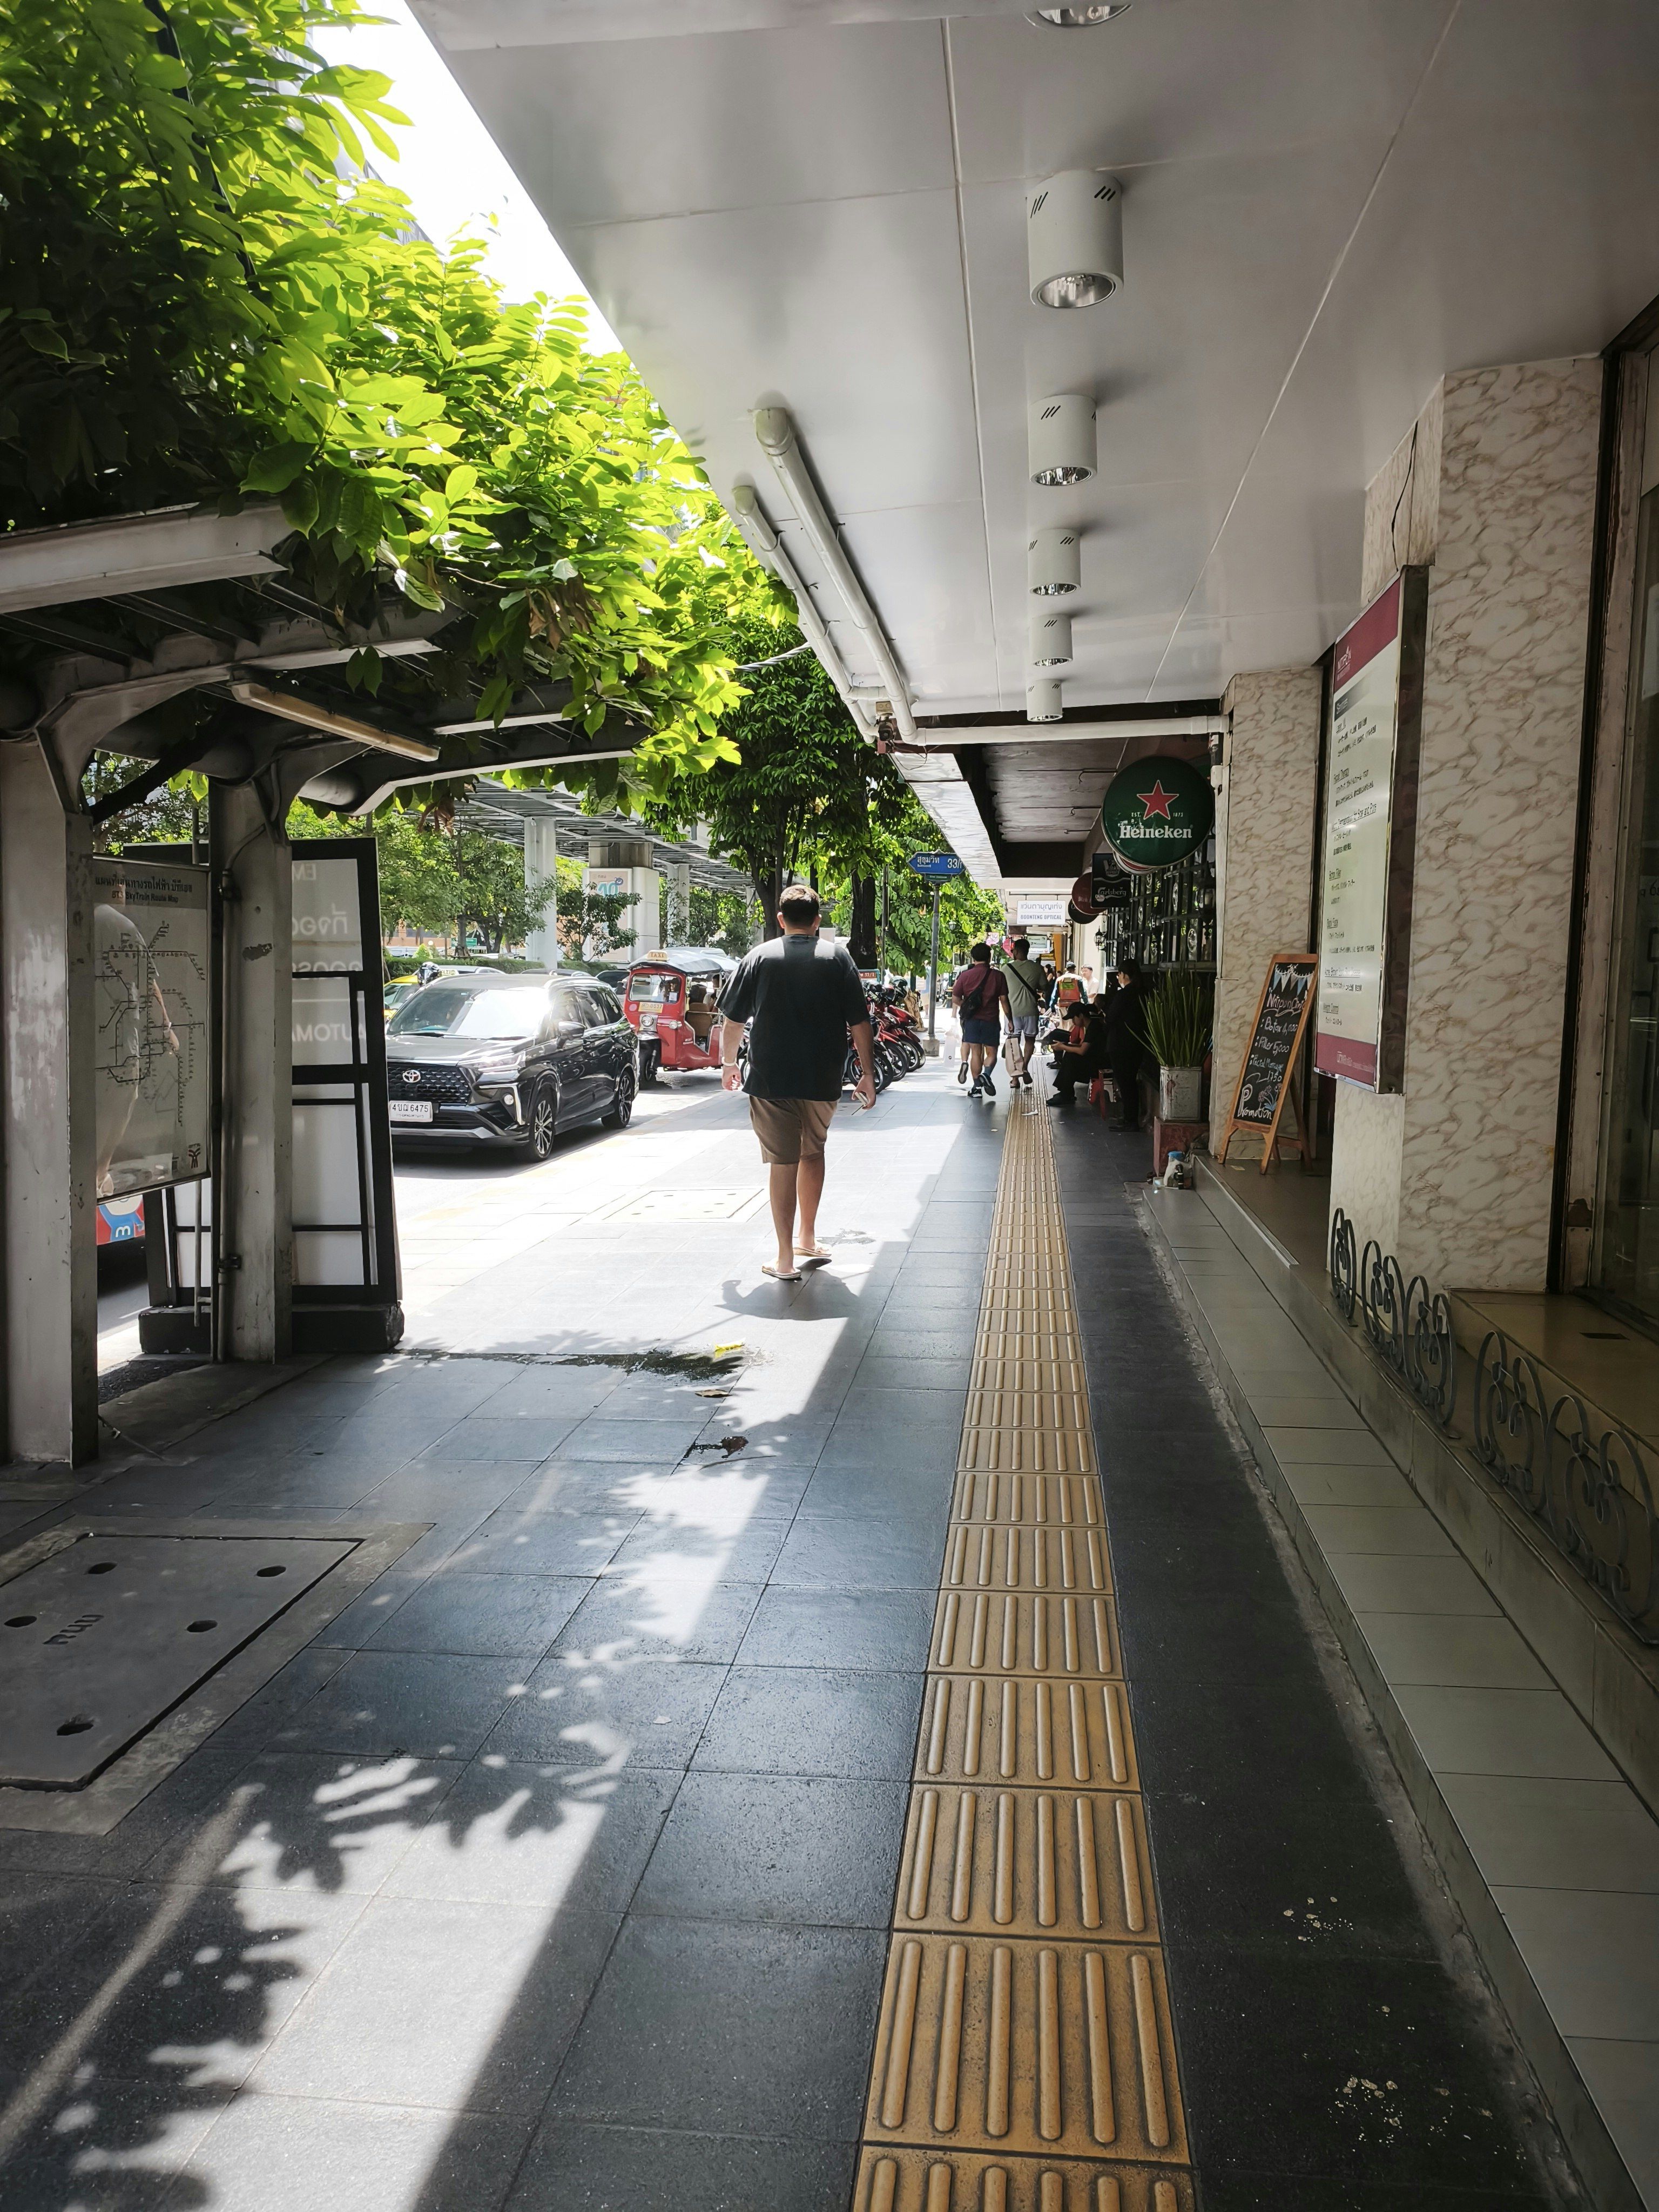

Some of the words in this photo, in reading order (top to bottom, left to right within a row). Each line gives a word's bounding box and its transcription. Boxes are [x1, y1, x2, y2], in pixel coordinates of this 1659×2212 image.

[1120, 826, 1192, 838] Heineken
[917, 855, 940, 865] สุขุมวิท
[1097, 887, 1127, 896] Carlsberg
[410, 1104, 429, 1112] 6475
